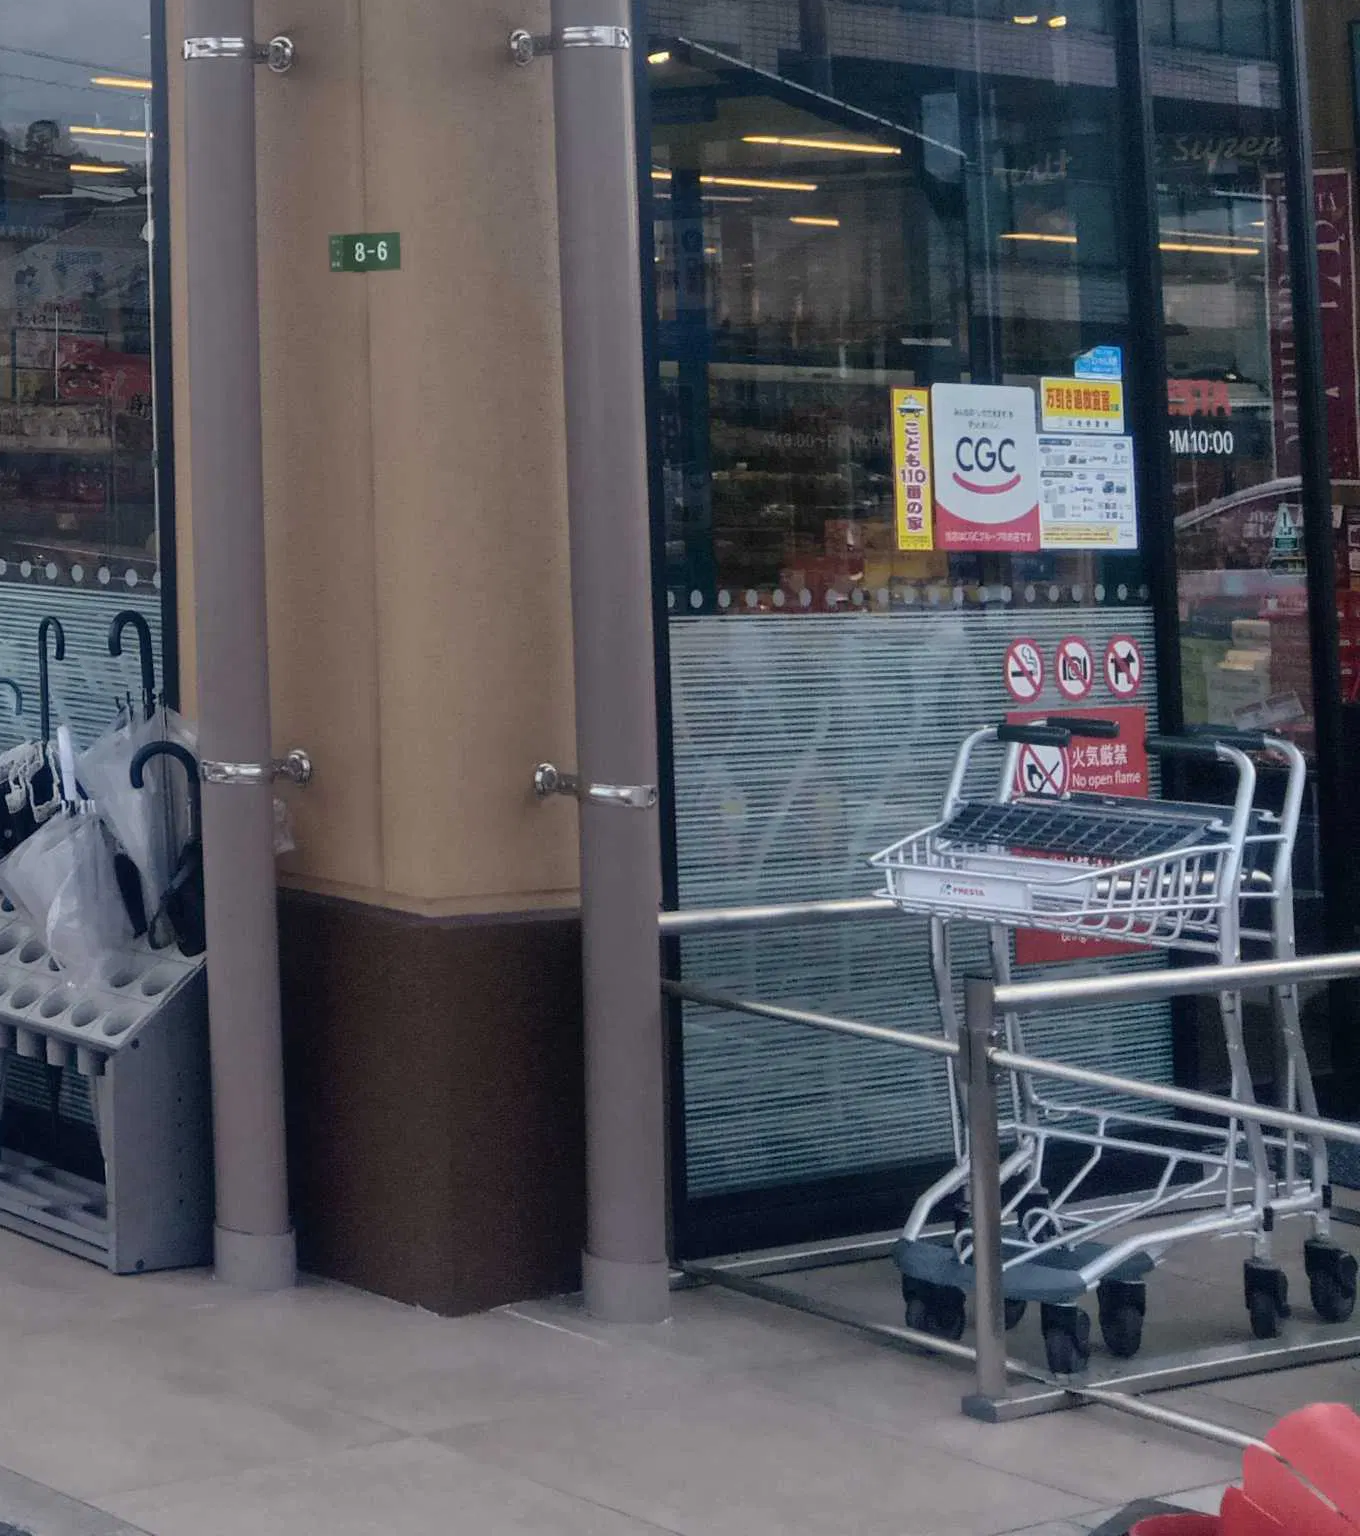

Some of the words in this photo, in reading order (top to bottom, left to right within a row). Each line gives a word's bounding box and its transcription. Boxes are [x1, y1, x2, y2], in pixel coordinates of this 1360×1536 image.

[355, 241, 387, 262] 8-6
[956, 436, 1016, 473] CGC
[1072, 743, 1128, 768] 火気厳禁
[1072, 775, 1087, 787] No
[1088, 776, 1113, 789] open
[1114, 771, 1141, 785] flame
